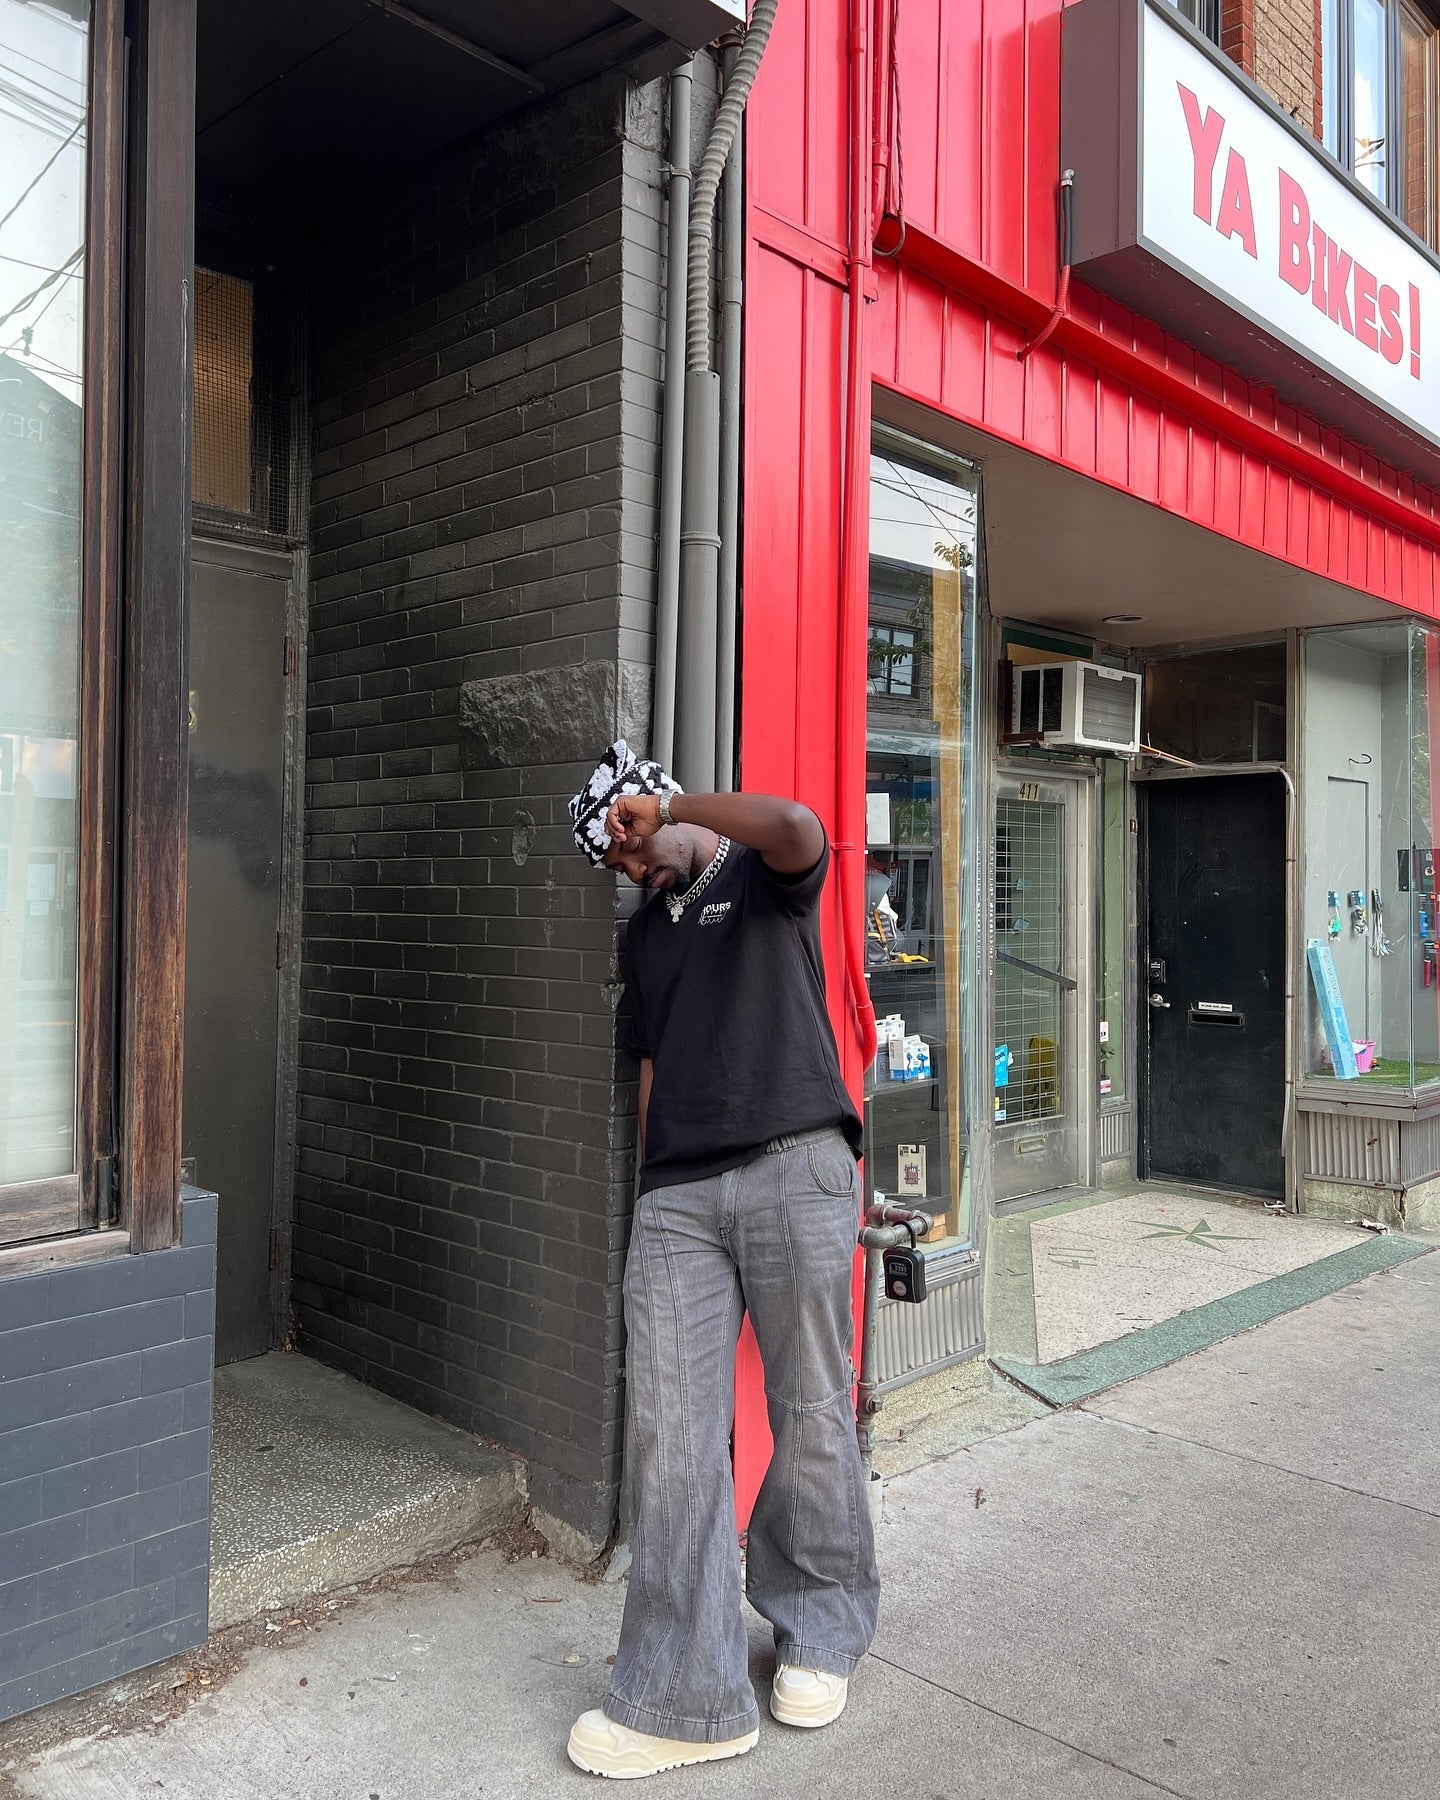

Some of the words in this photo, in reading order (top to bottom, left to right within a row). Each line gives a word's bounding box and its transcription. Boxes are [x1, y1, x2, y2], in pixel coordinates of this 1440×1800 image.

[1176, 80, 1258, 260] YA
[1278, 167, 1421, 380] BIKES!
[1019, 782, 1040, 800] 411
[1047, 1246, 1098, 1270] 411
